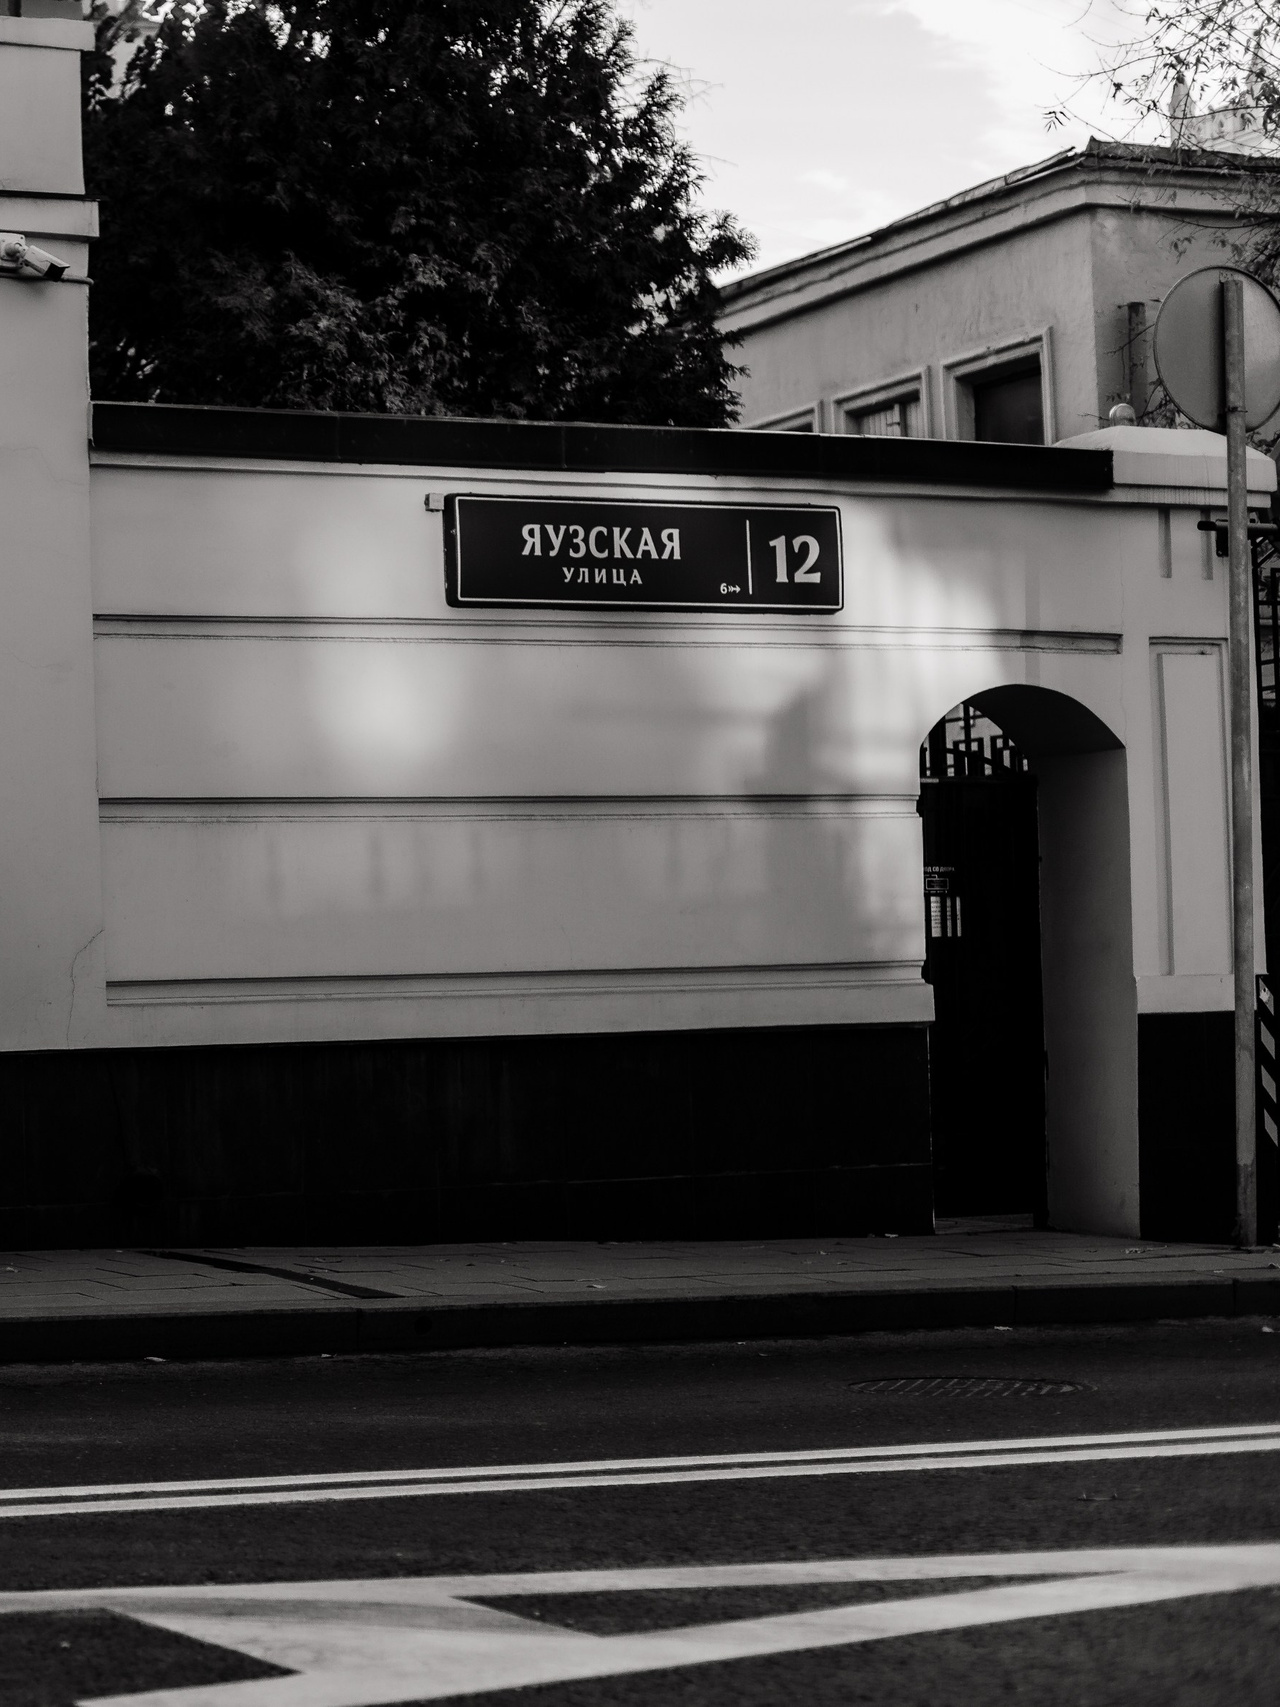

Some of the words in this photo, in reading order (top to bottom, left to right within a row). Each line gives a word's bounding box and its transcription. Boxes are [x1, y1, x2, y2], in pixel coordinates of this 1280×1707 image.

[521, 523, 682, 560] ЯУЗСКАЯ
[768, 534, 822, 584] 12
[562, 566, 643, 587] УЛИЦА
